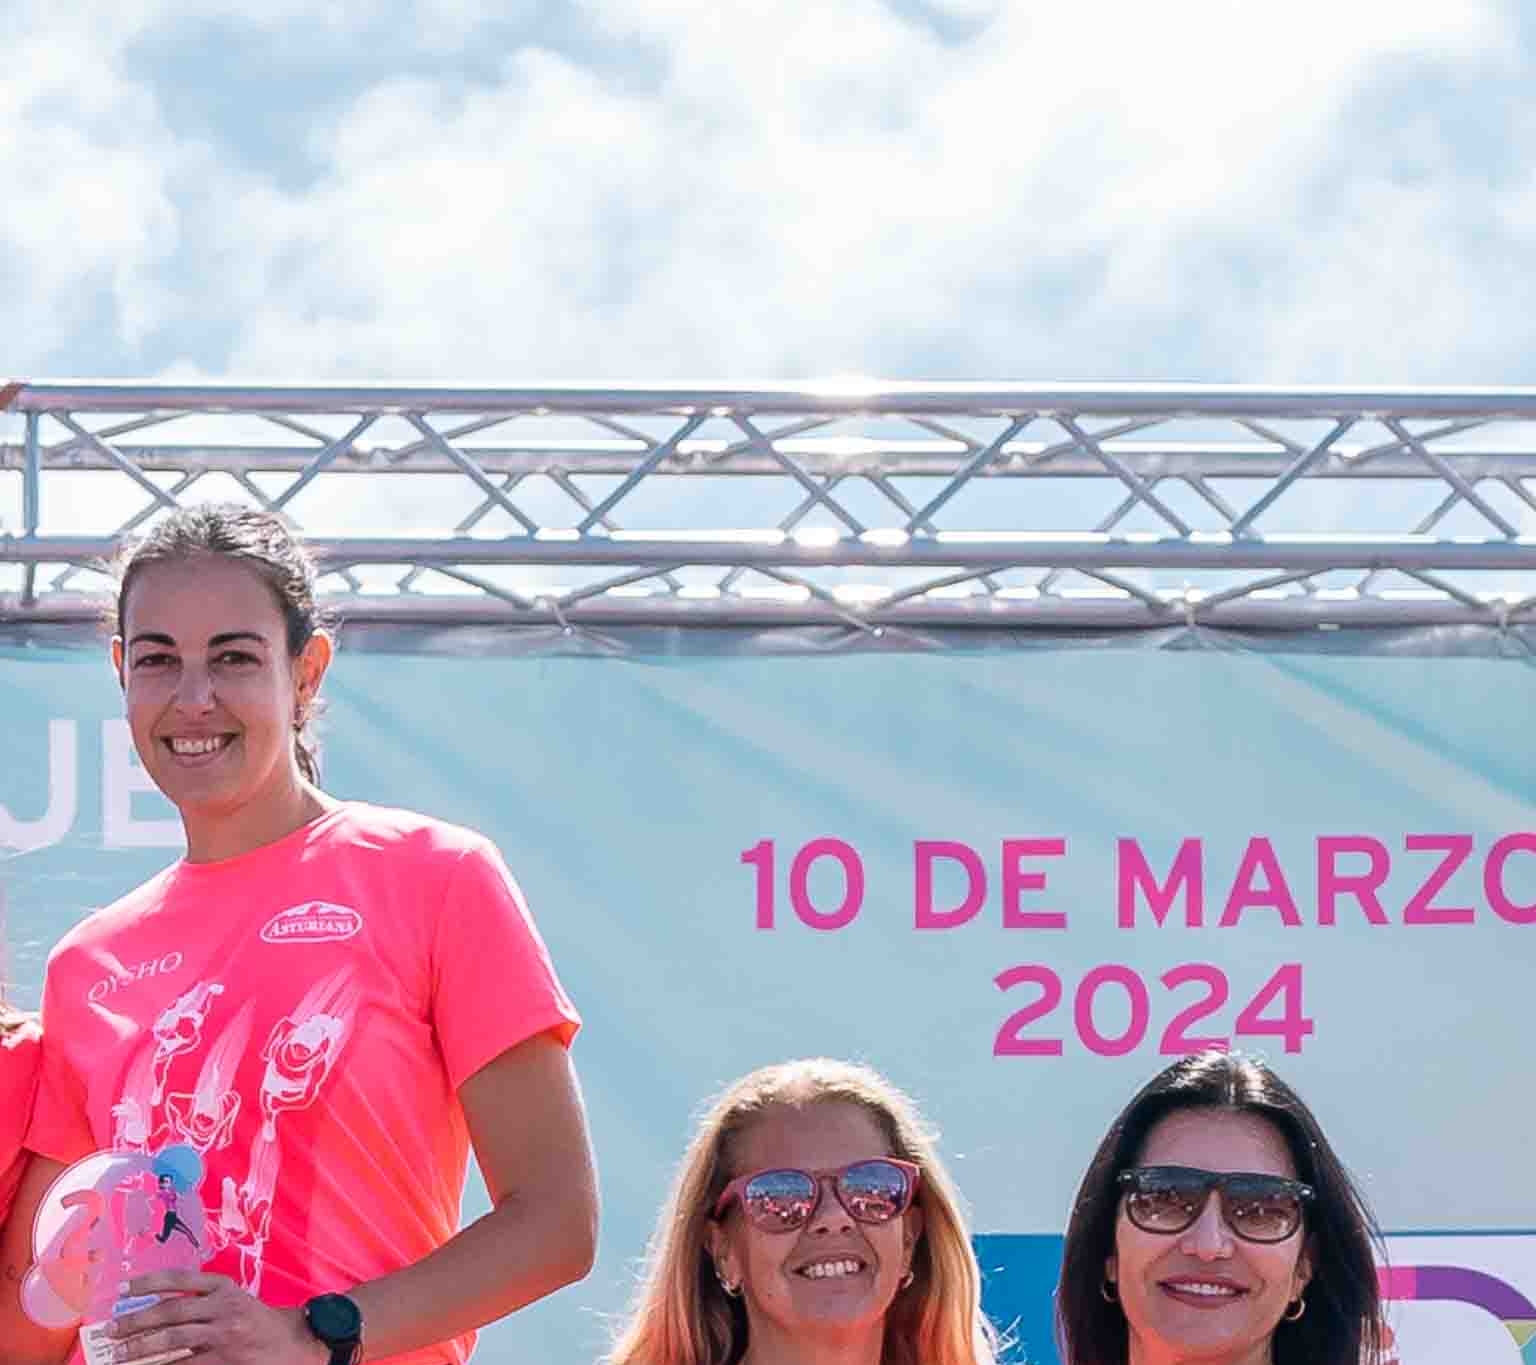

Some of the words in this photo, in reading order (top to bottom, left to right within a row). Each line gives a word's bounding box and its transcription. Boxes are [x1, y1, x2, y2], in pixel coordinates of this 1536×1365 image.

[740, 838, 865, 931] 10
[913, 838, 1068, 930] DE
[88, 951, 184, 1002] OYSHO
[993, 964, 1316, 1057] 2024
